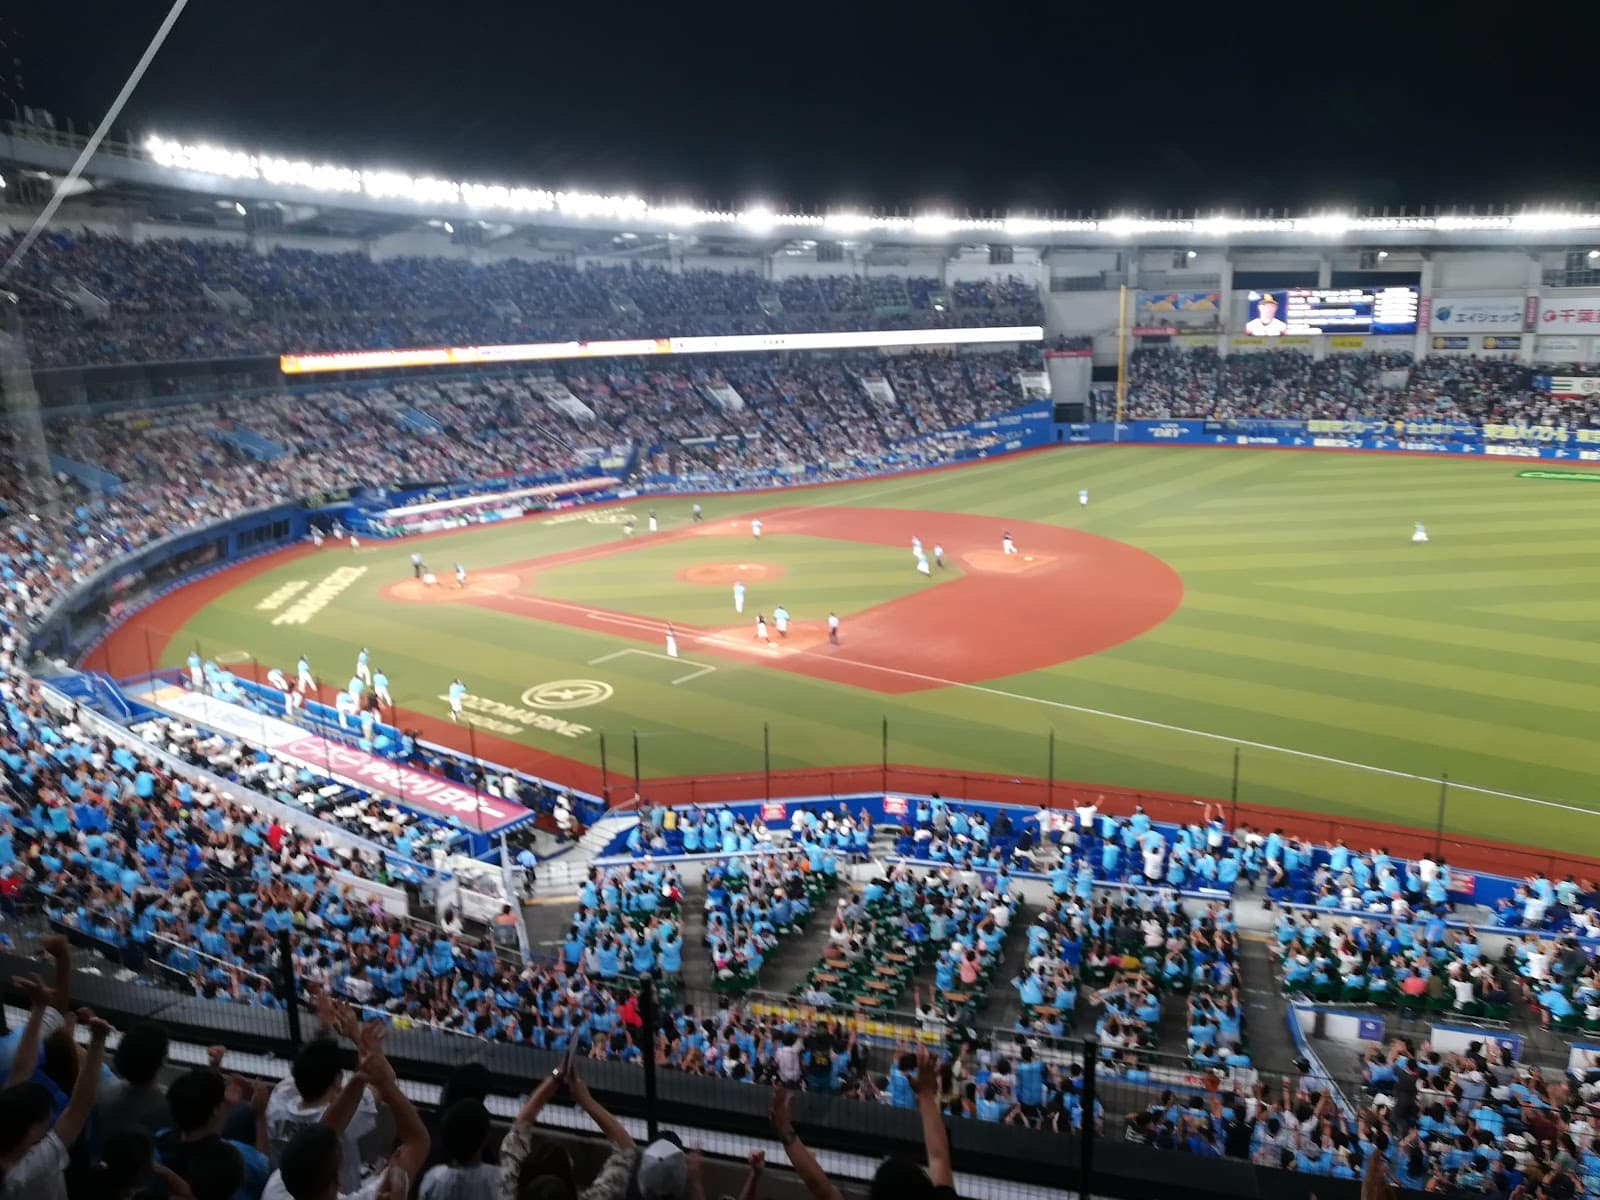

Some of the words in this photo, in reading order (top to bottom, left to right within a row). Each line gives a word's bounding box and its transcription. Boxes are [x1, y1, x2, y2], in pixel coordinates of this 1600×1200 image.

[1456, 312, 1522, 323] エイジェック
[1559, 309, 1600, 324] 千葉
